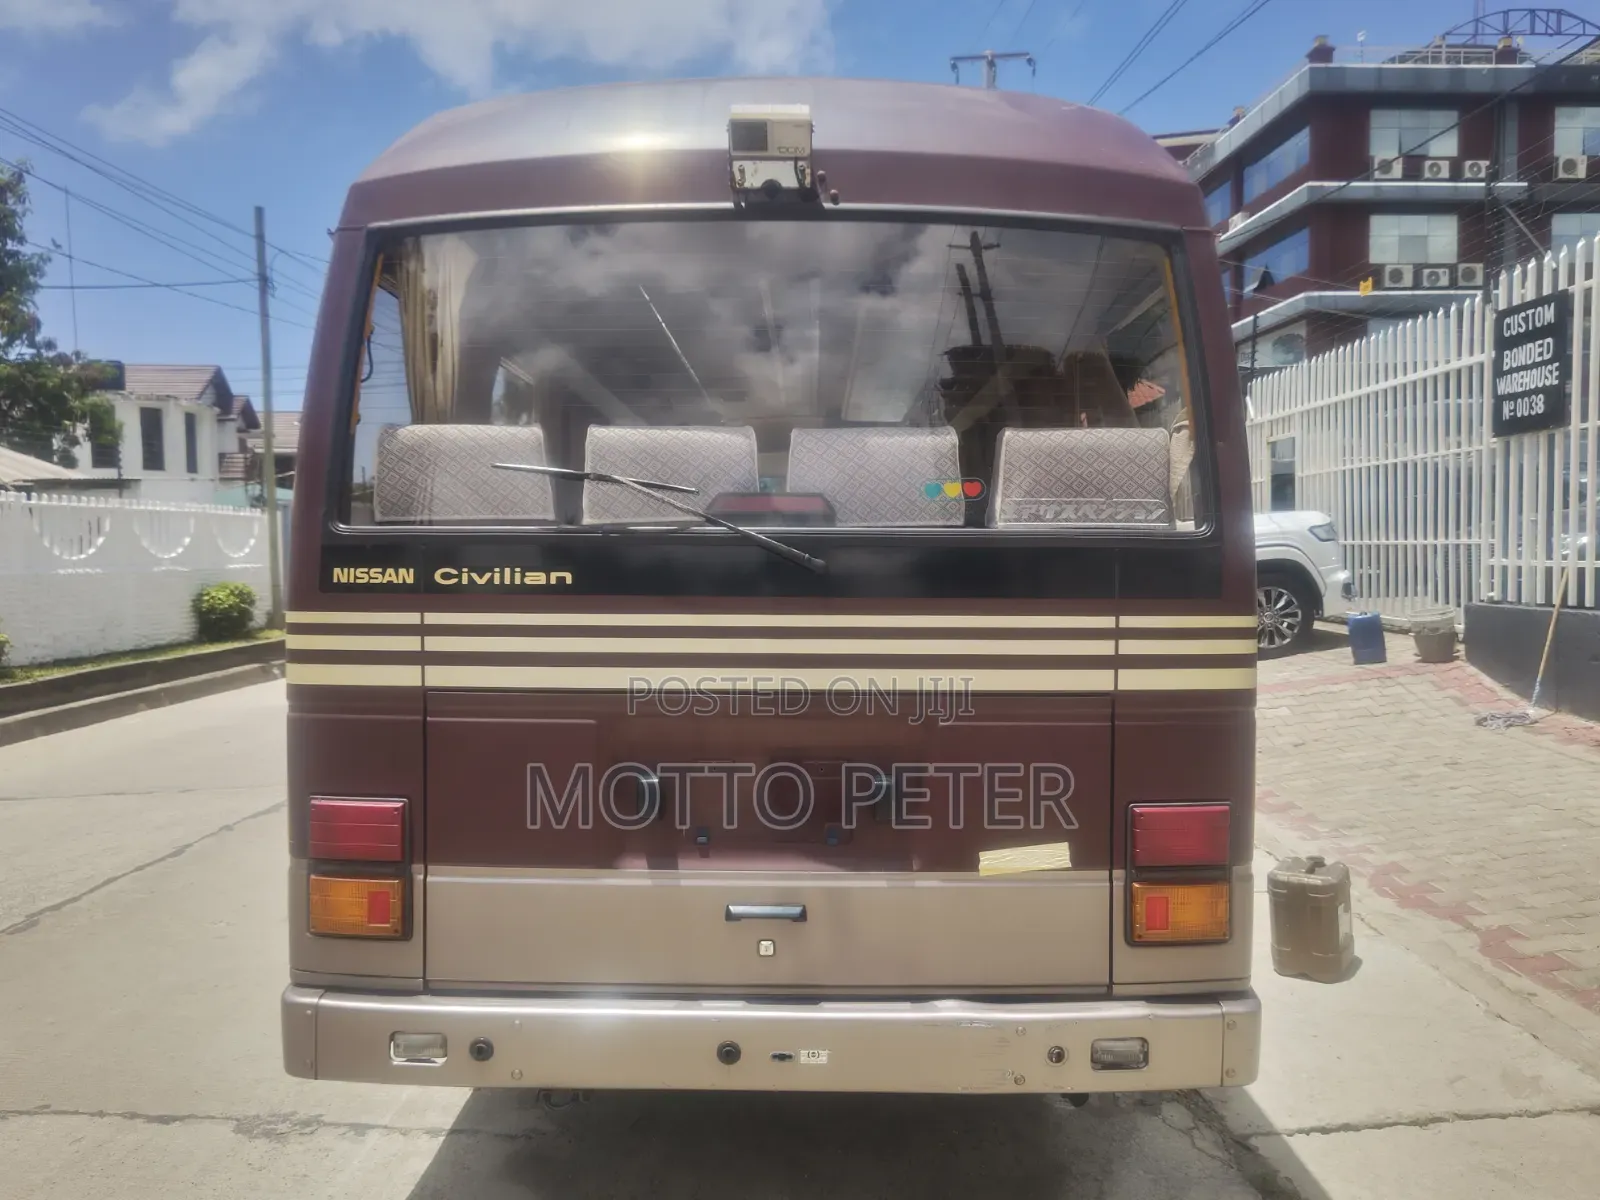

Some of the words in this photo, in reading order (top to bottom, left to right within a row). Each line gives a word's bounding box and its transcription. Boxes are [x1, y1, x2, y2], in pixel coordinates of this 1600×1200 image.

[1503, 302, 1555, 338] CUSTOM
[1502, 337, 1554, 371] BONDED
[1496, 362, 1560, 396] WAREHOUSE
[1516, 394, 1545, 418] 0038
[332, 567, 414, 584] NISSAN
[433, 567, 573, 585] Civilian
